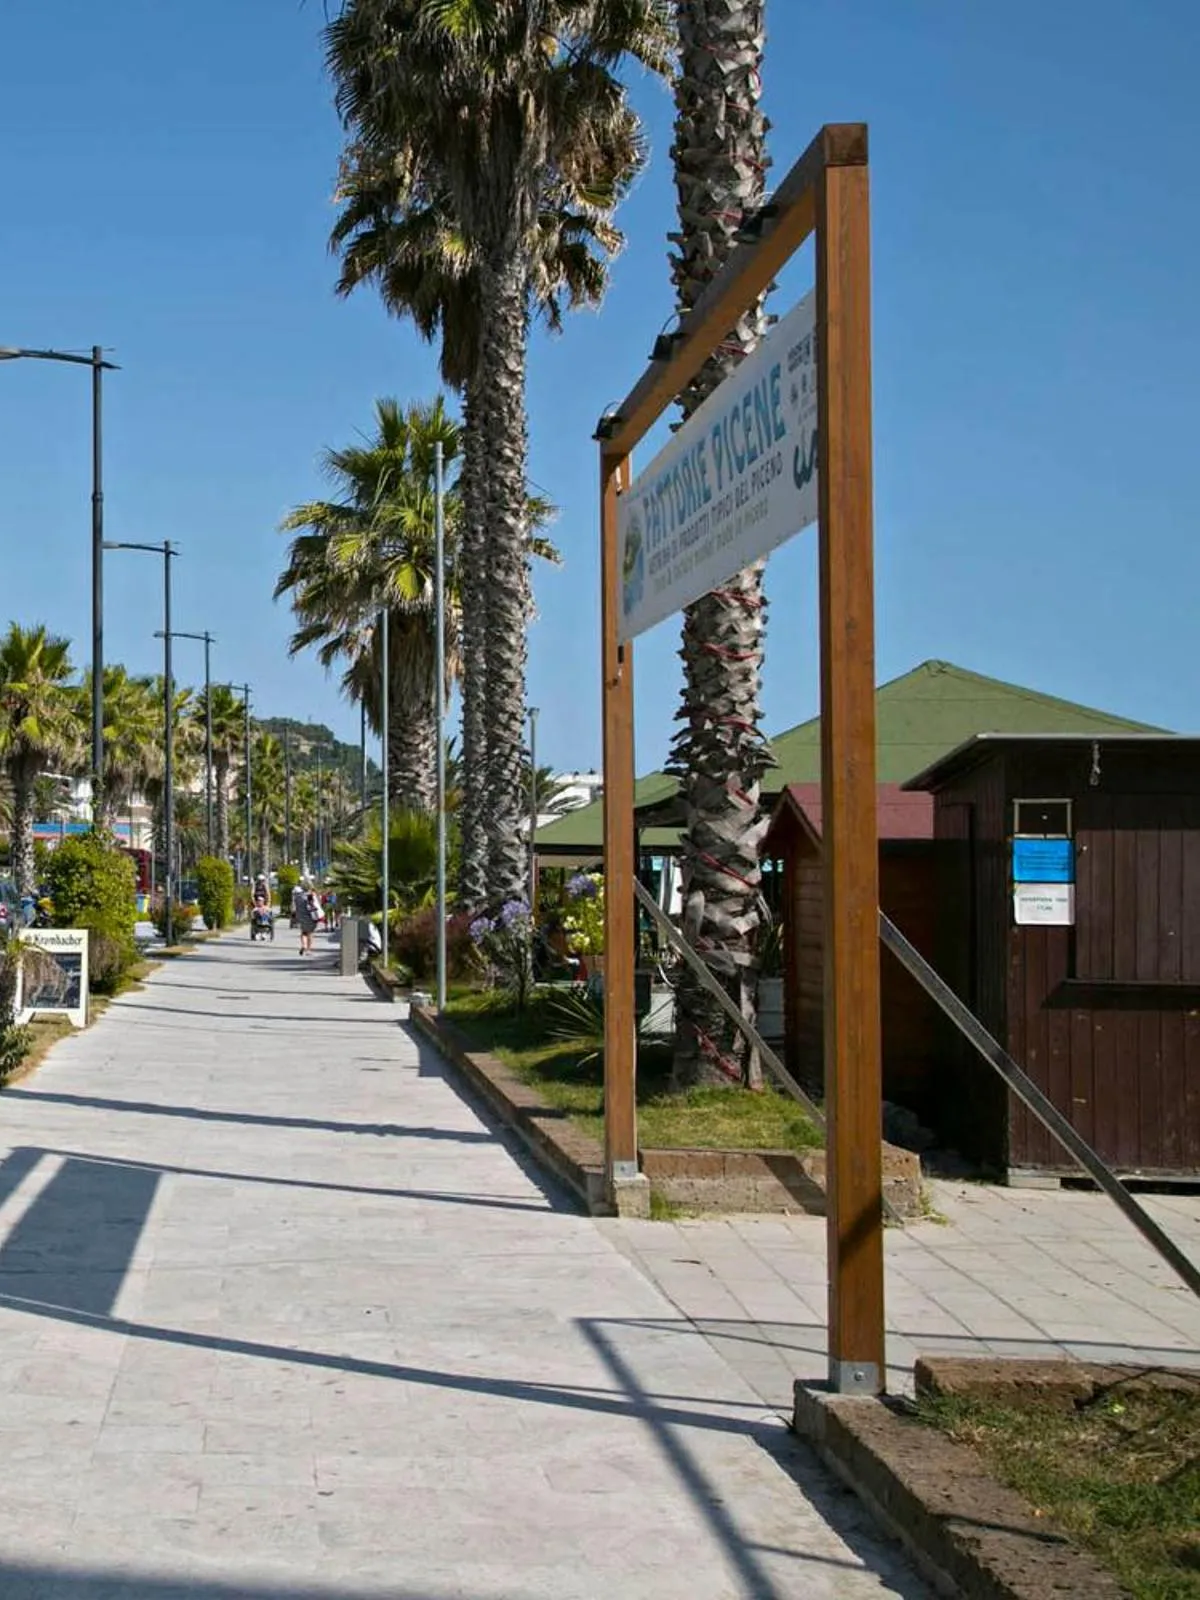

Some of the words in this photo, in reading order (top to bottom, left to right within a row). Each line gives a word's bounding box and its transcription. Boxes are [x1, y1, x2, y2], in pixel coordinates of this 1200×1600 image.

[712, 361, 787, 491] PICENE
[736, 480, 750, 509] DEL
[752, 450, 784, 495] PICENO
[34, 933, 83, 946] Krombacher
